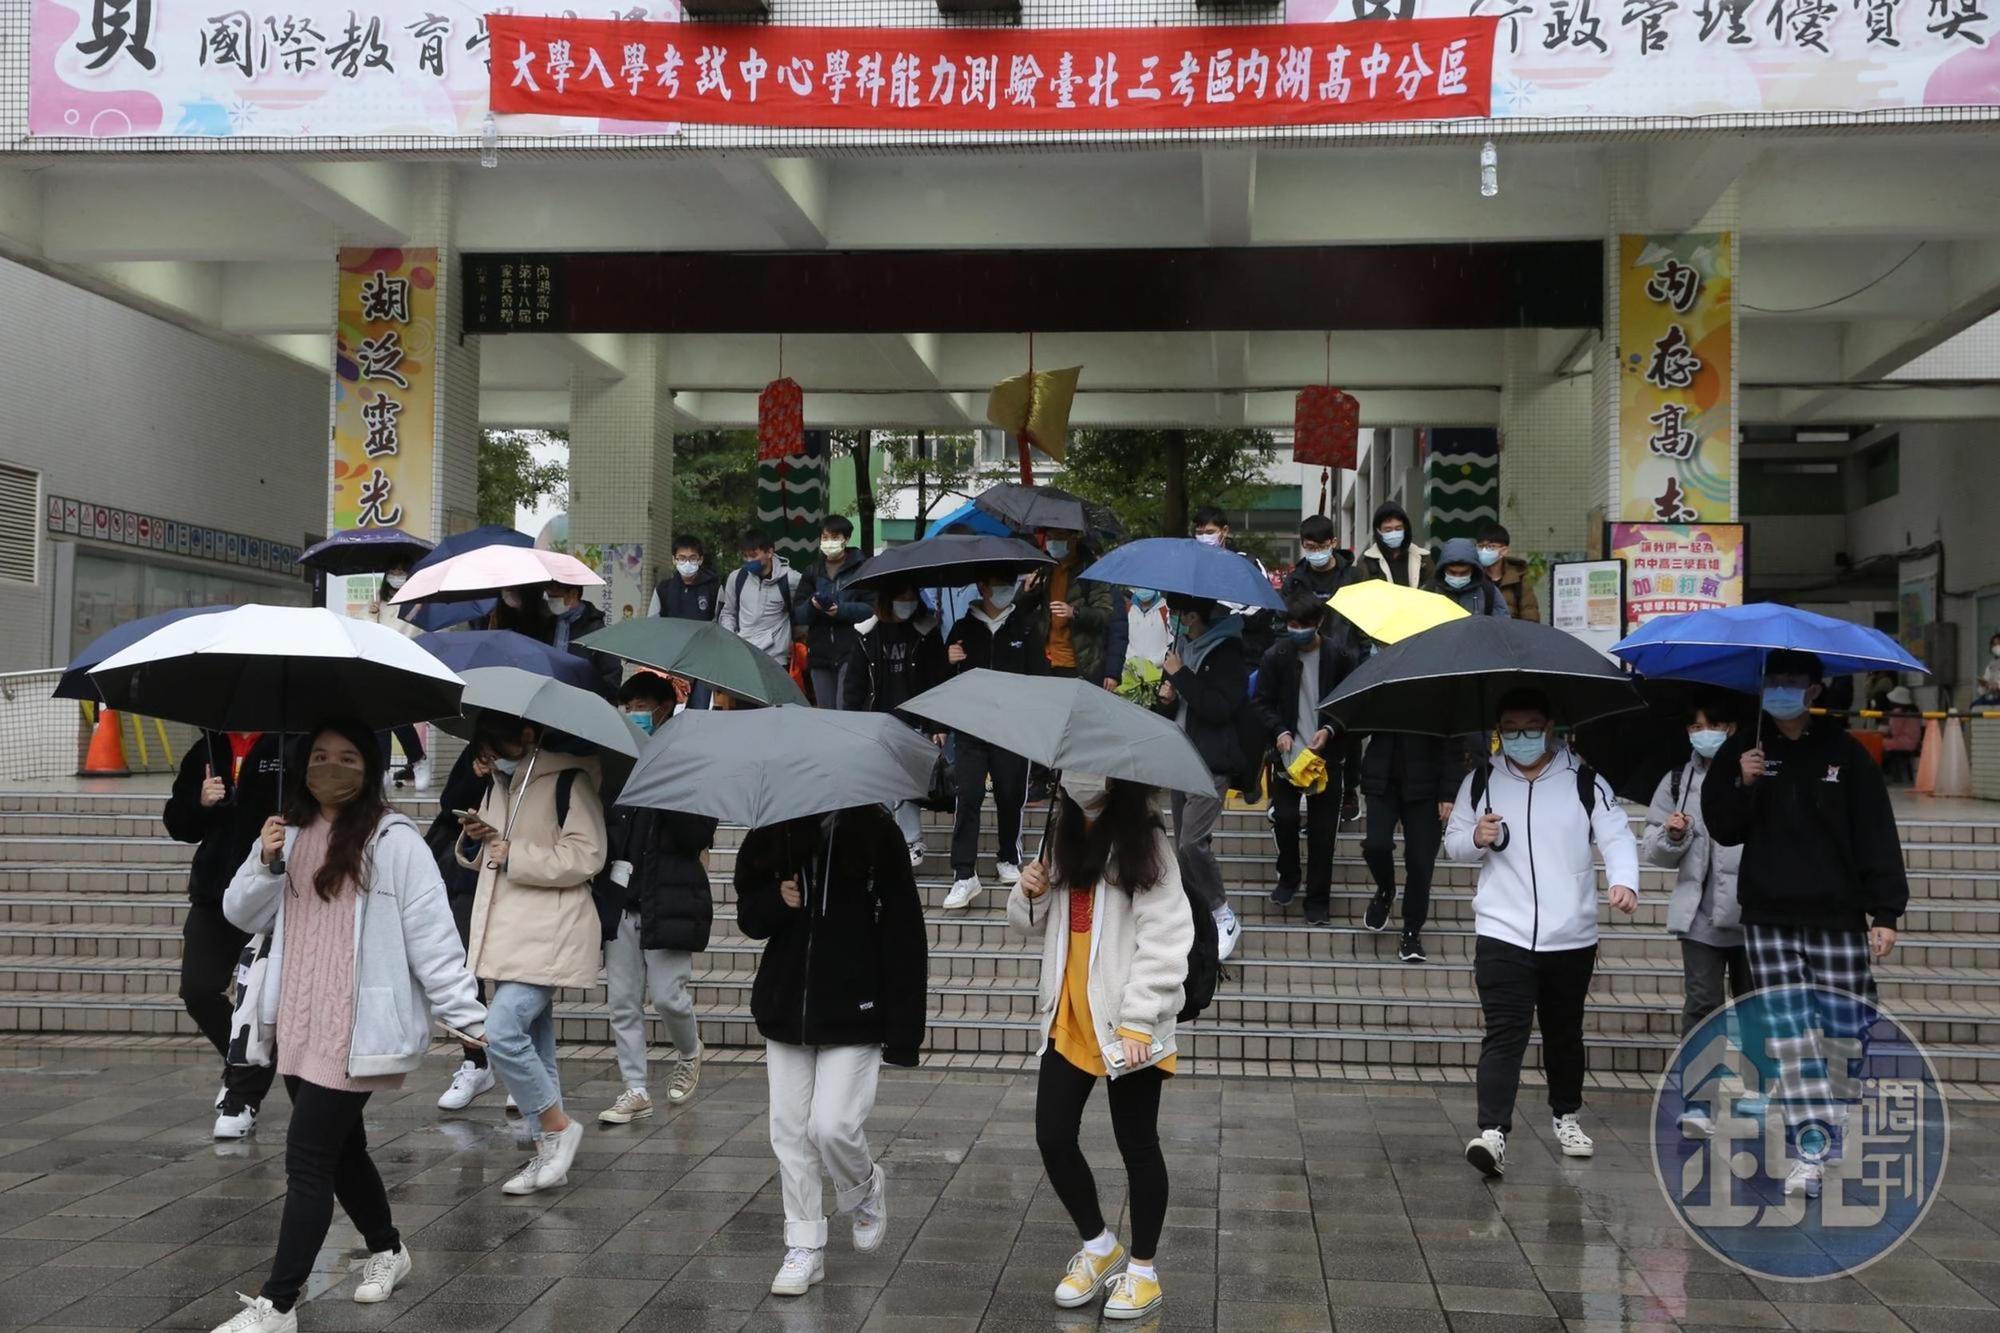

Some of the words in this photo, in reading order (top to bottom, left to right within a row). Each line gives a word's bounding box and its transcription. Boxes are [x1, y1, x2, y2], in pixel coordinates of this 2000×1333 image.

[536, 265, 550, 323] 內湖高中
[358, 271, 409, 526] 湖泛靈光
[1641, 541, 1714, 553] 讓我們一起為
[1632, 575, 1721, 598] 加油打氣
